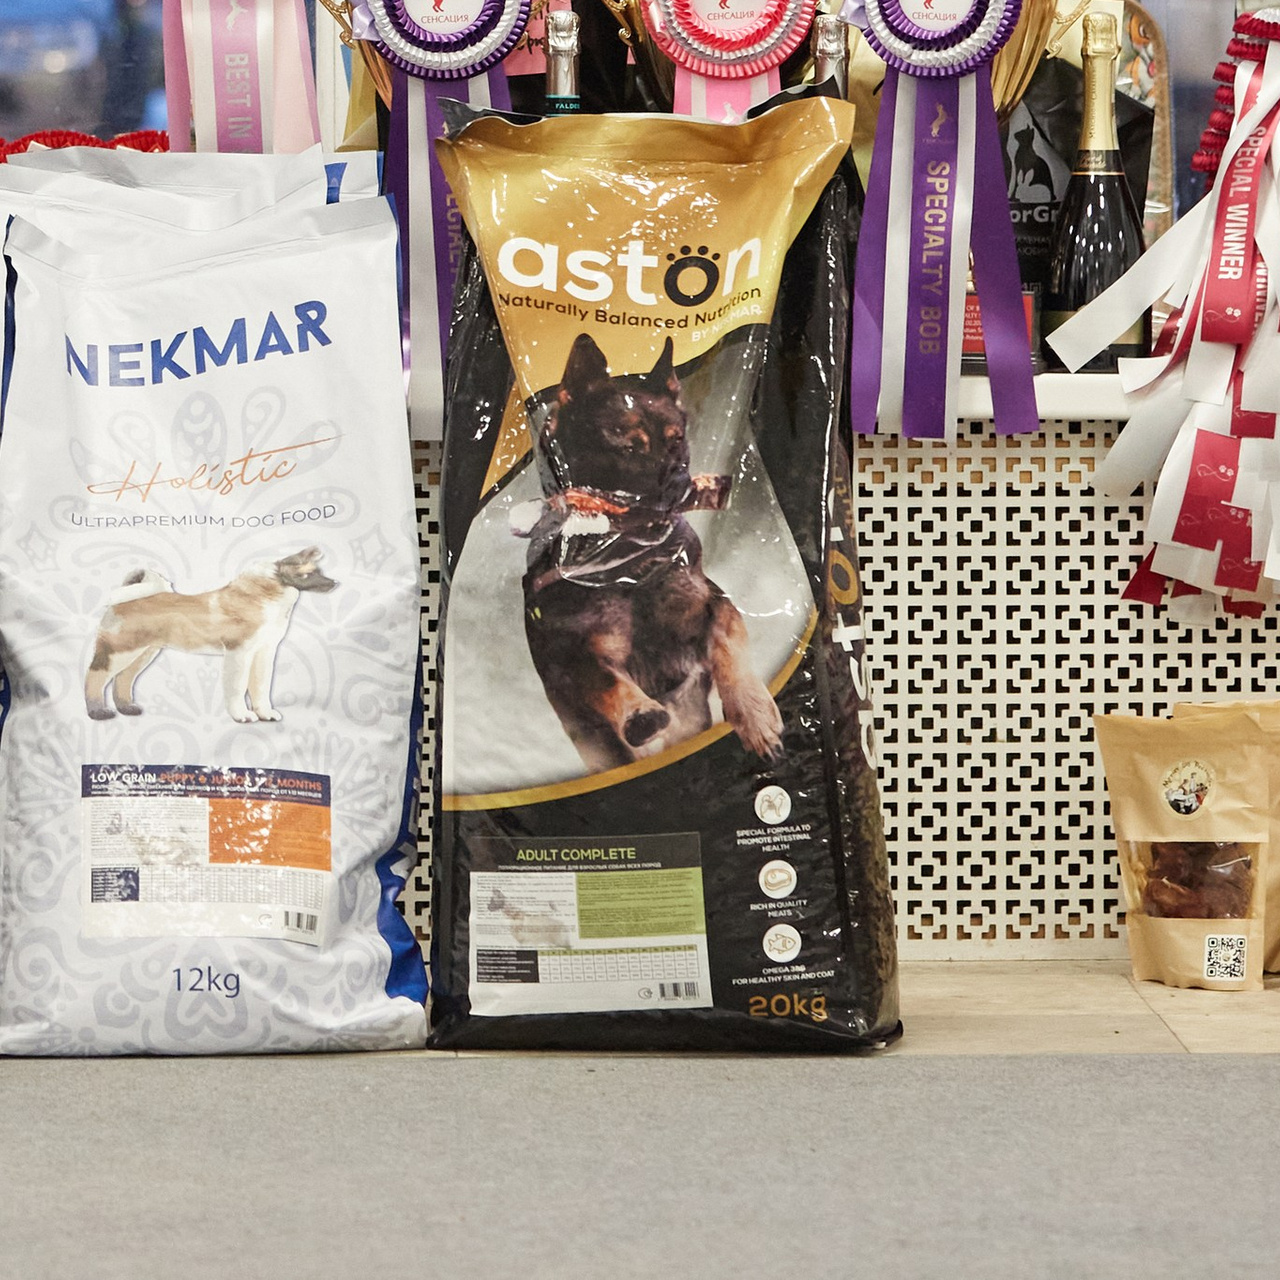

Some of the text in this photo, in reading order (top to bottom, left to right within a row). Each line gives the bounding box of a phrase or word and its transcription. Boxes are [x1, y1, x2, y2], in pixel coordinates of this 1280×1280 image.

[420, 14, 469, 24] СЕНСАЦИЯ
[707, 9, 755, 21] СЕНСАЦИЯ
[911, 9, 958, 21] СЕНСАЦИЯ
[224, 52, 253, 139] BEST IN
[1218, 125, 1267, 280] SPECIAL WINNER
[922, 160, 950, 297] SPECIALTY
[497, 235, 762, 307] aston
[498, 286, 762, 329] Naturally Balanced Nutrition
[691, 329, 708, 342] BY
[918, 305, 942, 356] BOB
[64, 300, 333, 388] NEKMAR
[86, 434, 346, 503] Holistic
[70, 504, 337, 528] ULTRAPREMIUM DOG FOOD
[91, 773, 118, 783] LOW
[122, 773, 156, 783] GRAIN
[160, 773, 195, 783] PUPPY
[277, 778, 322, 791] MONTHS
[736, 824, 811, 837] SPECIAL FORMULA TO
[737, 833, 811, 846] PROMOTE INTESTINAL
[516, 847, 636, 861] ADULT COMPLETE
[762, 844, 790, 852] HEALTH
[750, 903, 768, 911] RICH
[776, 899, 808, 909] QUALITY
[732, 970, 835, 986] FOR HEALTHY SKIN AND COAT
[762, 966, 789, 975] OMEGA
[172, 966, 240, 998] 12kg
[749, 993, 828, 1022] 20kg
